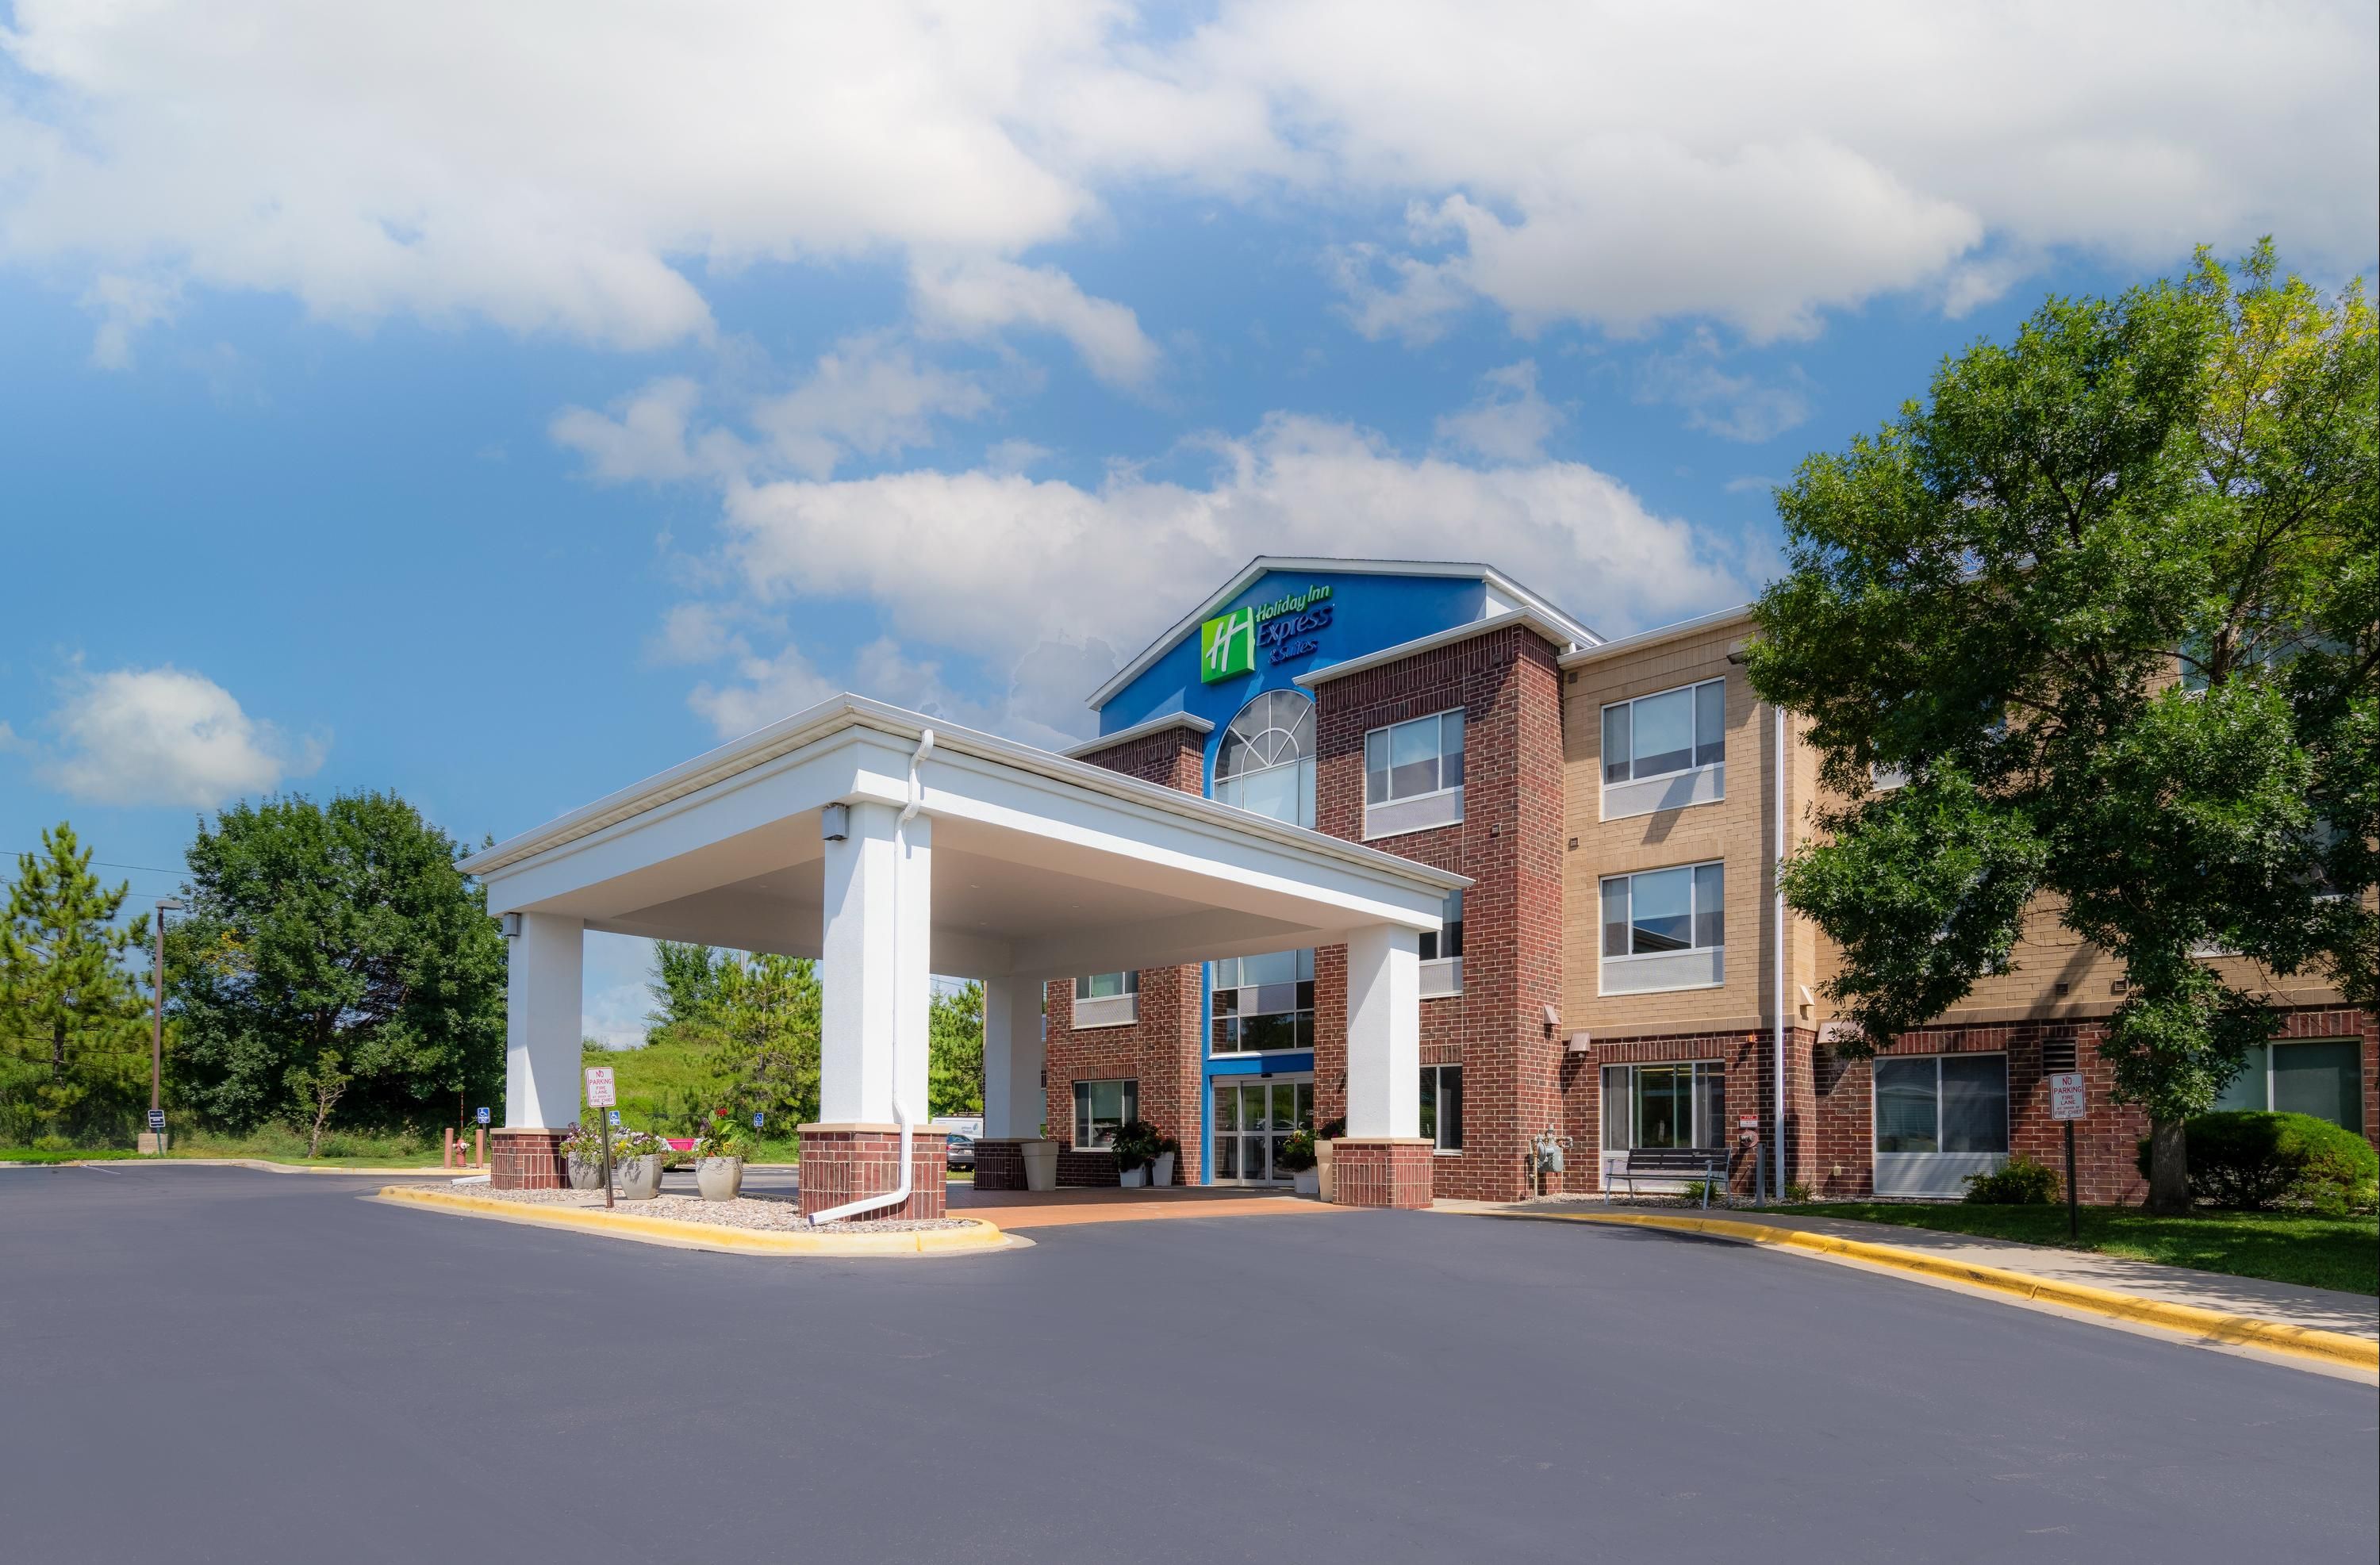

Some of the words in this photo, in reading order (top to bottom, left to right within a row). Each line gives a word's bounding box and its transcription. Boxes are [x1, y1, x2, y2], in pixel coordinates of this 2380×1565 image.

[1256, 594, 1307, 622] Holiday
[1307, 585, 1330, 602] Inn
[1256, 606, 1333, 646] Express
